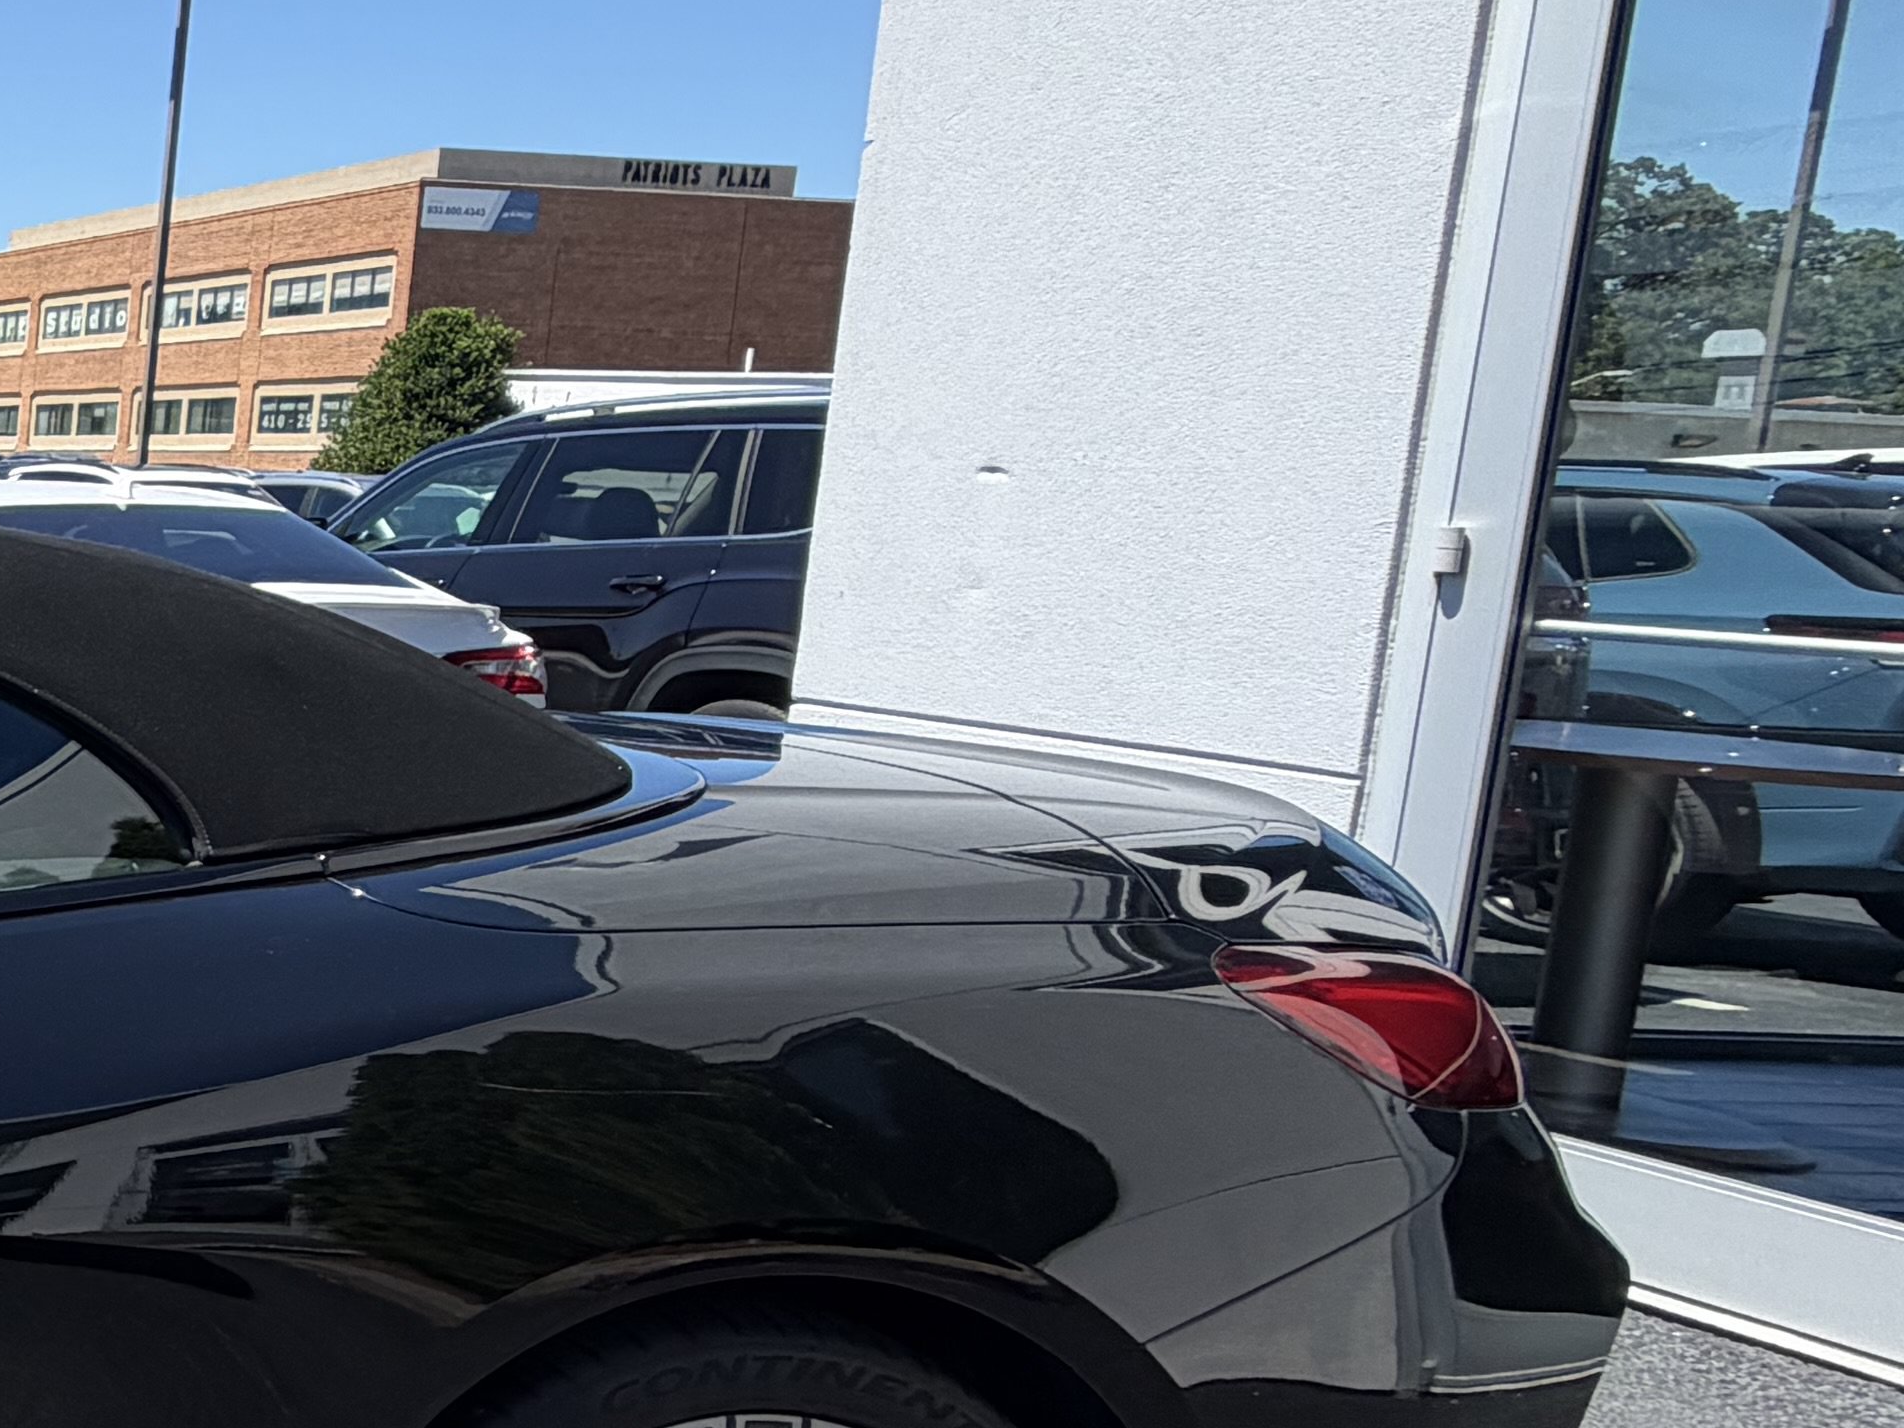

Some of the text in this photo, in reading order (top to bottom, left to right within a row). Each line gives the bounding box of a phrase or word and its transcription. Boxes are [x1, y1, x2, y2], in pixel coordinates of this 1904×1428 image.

[621, 159, 772, 190] PATRIOTS PLAZA
[45, 307, 127, 334] Studio
